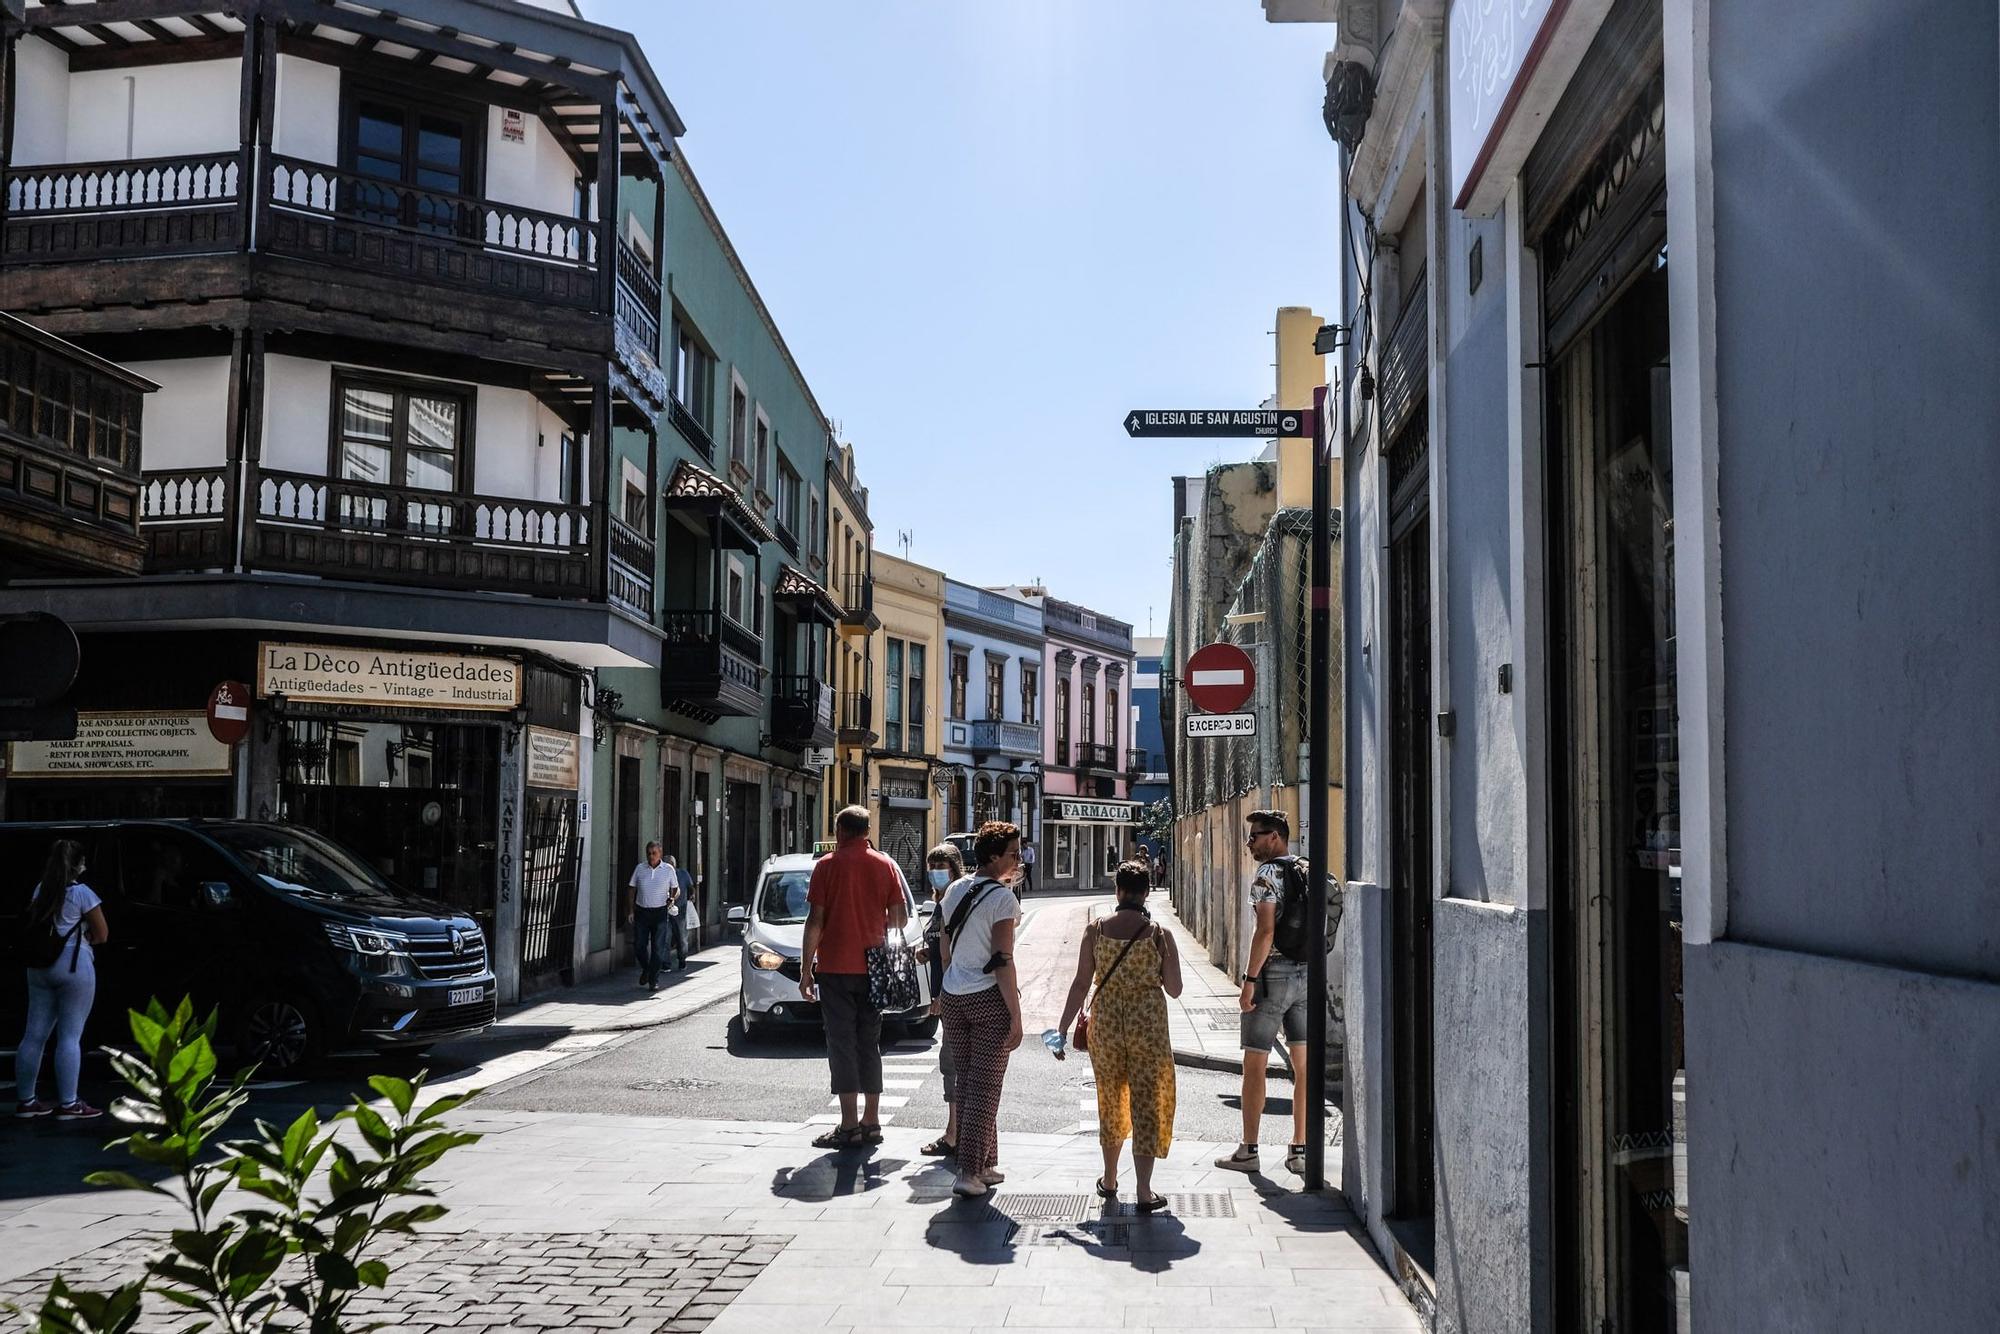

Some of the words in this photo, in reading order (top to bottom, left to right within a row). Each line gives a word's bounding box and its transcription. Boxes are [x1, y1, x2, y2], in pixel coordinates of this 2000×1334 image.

[1145, 412, 1187, 425] IGLESIA
[1190, 412, 1203, 425] DE
[1207, 412, 1229, 425] SAN
[1233, 410, 1278, 425] AGUSTÍN
[1255, 427, 1278, 435] CHURCH
[268, 649, 297, 671] La
[303, 652, 360, 674] Dèco
[368, 655, 514, 683] Antigüedades
[268, 676, 364, 693] Antigüedades
[383, 682, 434, 698] Vintage
[452, 686, 513, 701] Industrial
[95, 719, 113, 727] AND
[114, 719, 134, 727] SALE
[135, 719, 146, 727] OF
[148, 717, 190, 728] ANTIQUES
[1235, 718, 1253, 730] BICI
[86, 729, 105, 738] AND
[105, 728, 158, 738] COLLECTING
[160, 727, 197, 738] OBJECTS.
[50, 740, 84, 749] MARKET
[86, 740, 134, 748] APPRAISALS.
[49, 751, 72, 759] RENT
[73, 750, 90, 758] FOR
[137, 760, 154, 768] ETC.
[1063, 804, 1129, 818] FARMACIA
[821, 843, 836, 852] TAXI
[501, 804, 513, 904] ANTIQUES
[453, 990, 470, 1004] 2217
